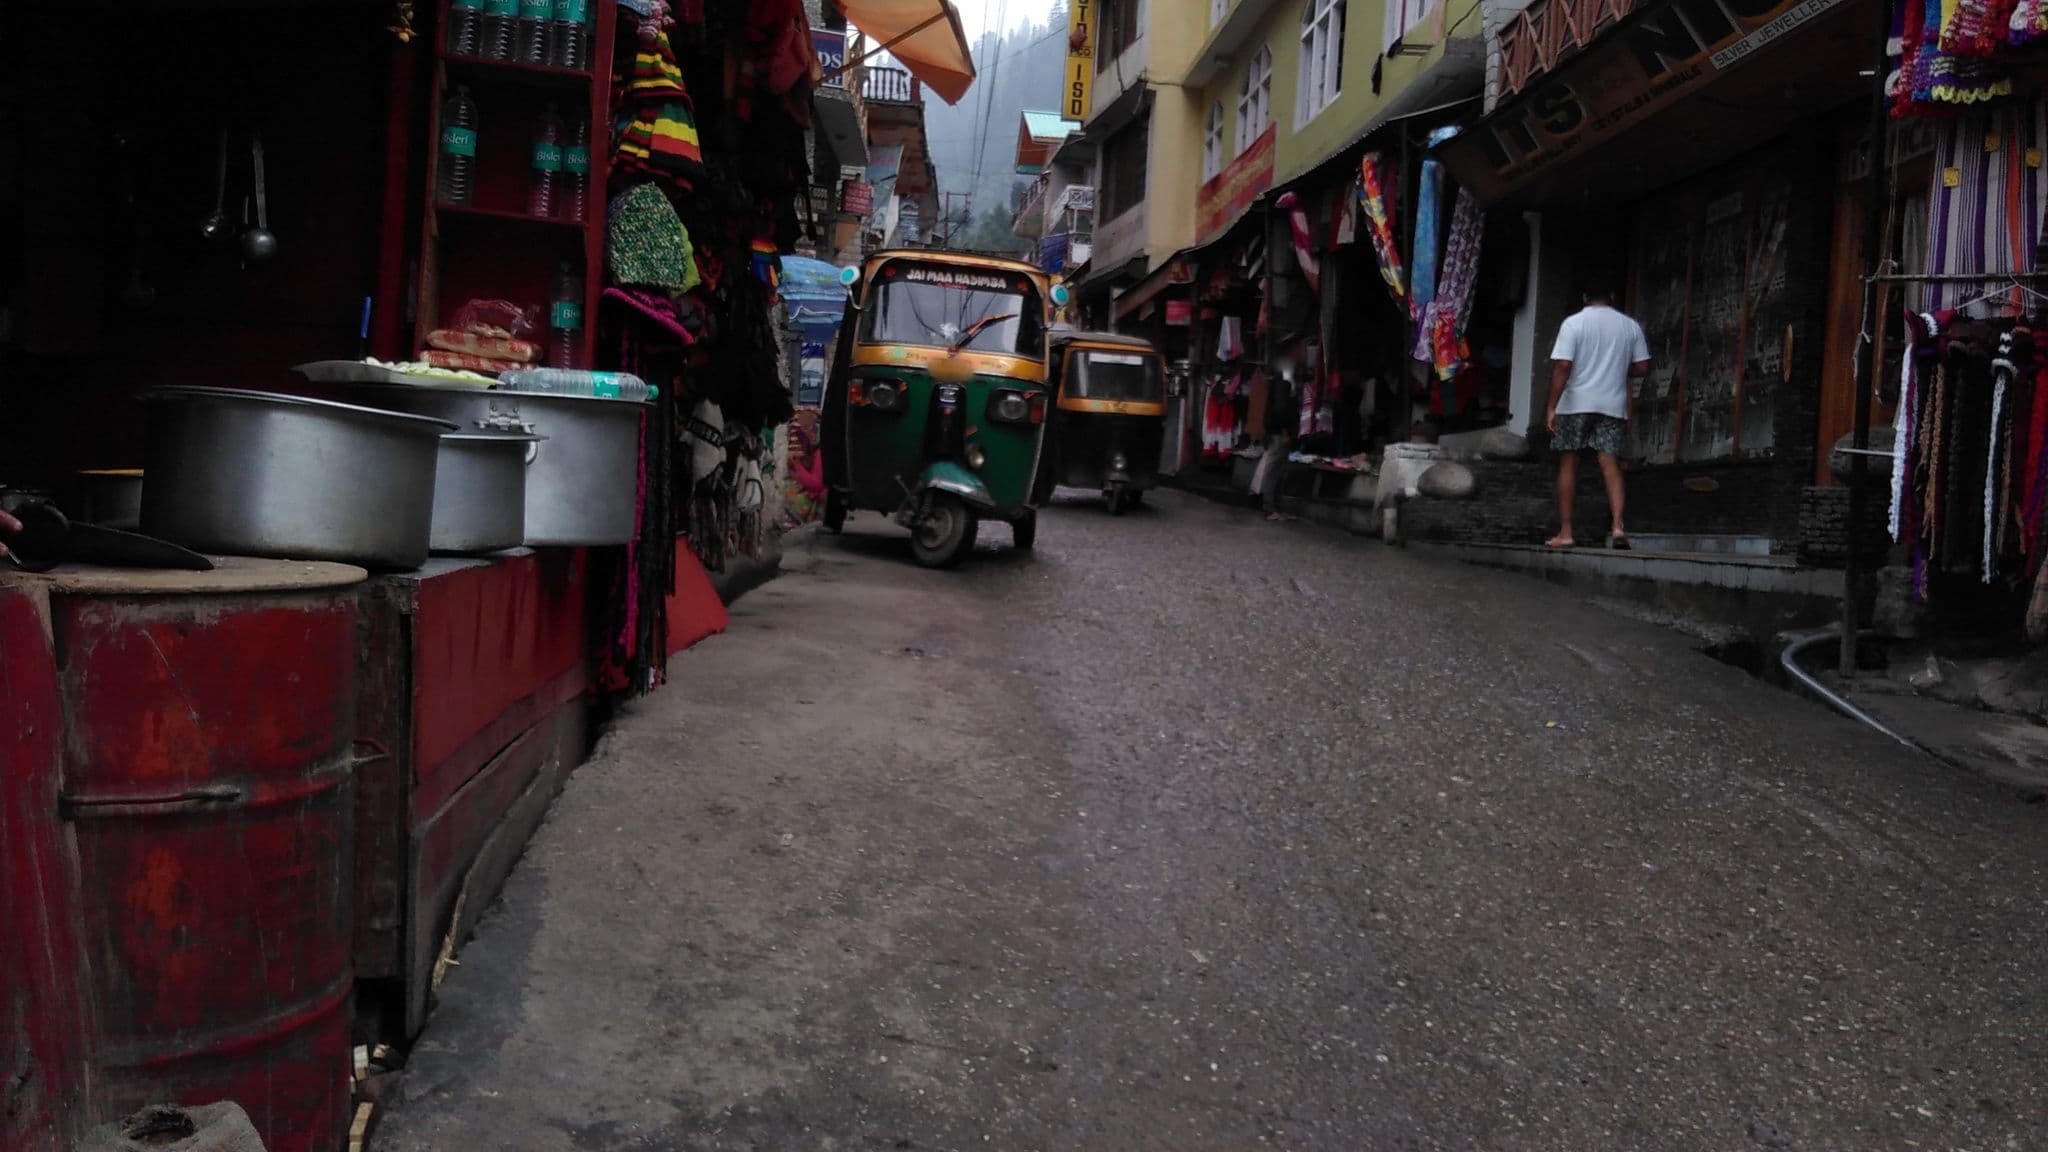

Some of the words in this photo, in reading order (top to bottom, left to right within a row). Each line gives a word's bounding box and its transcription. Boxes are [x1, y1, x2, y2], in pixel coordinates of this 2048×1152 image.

[1714, 40, 1752, 66] SILVER
[1072, 64, 1084, 115] ISD
[906, 269, 926, 280] JAI
[926, 270, 953, 283] MAA
[954, 273, 1007, 289] HADIMBA
